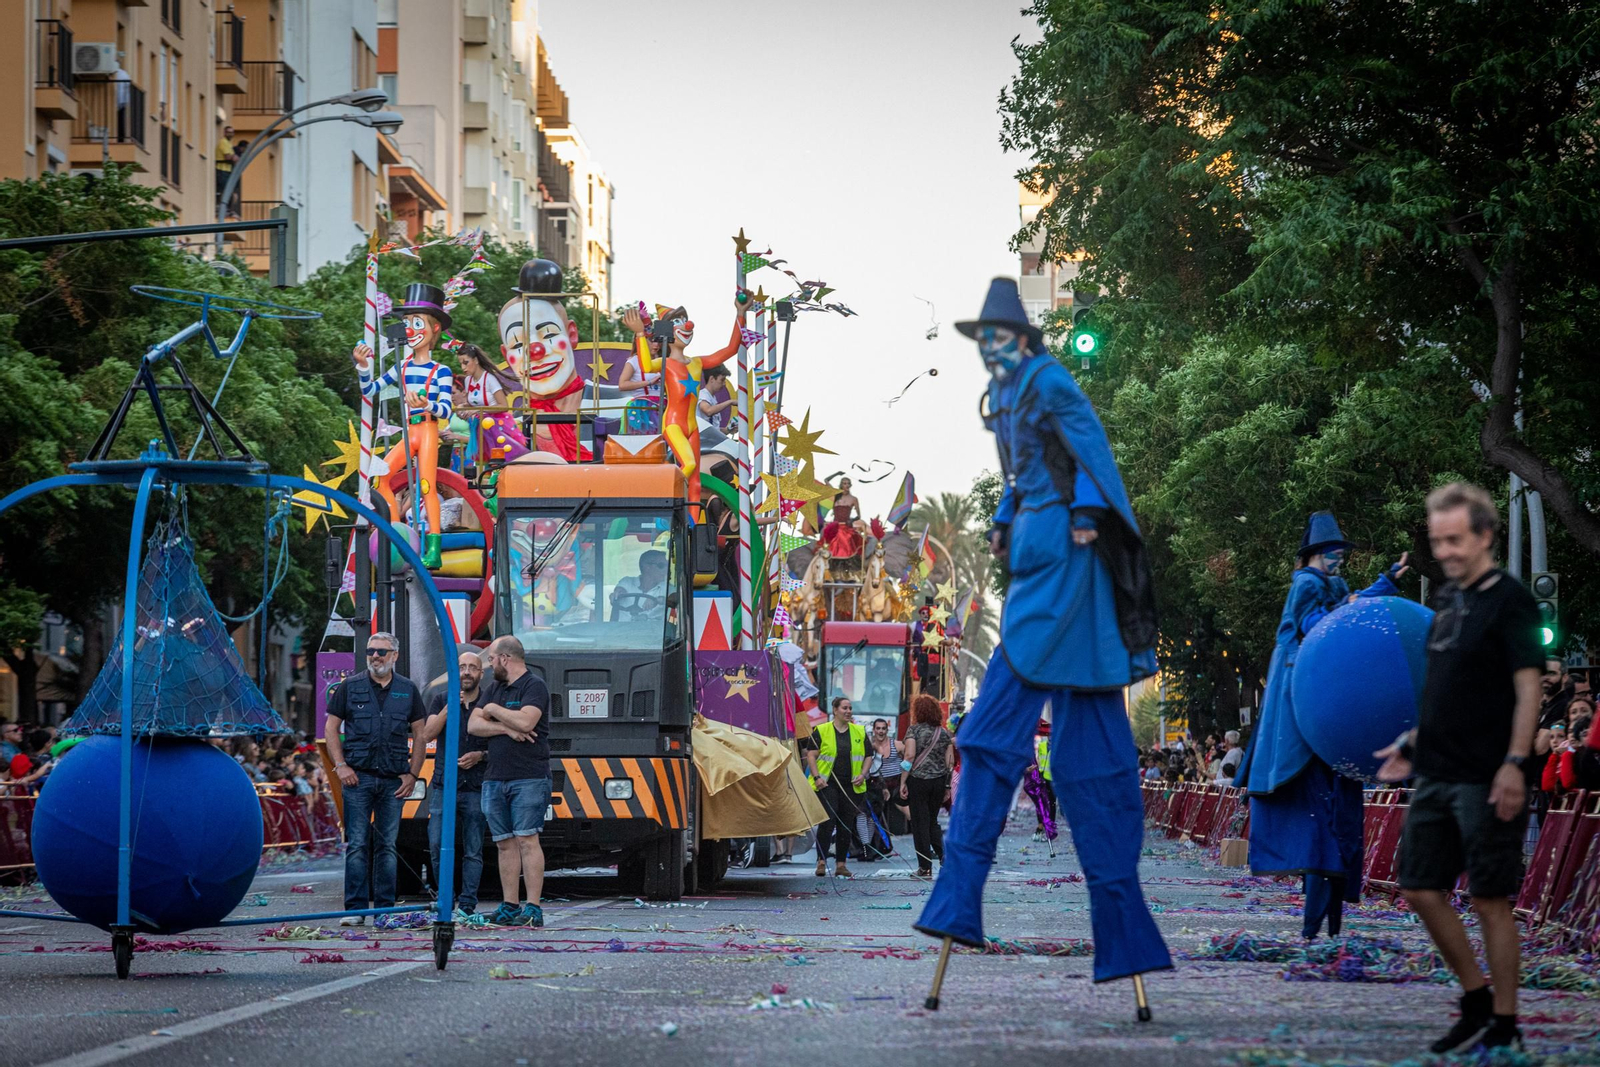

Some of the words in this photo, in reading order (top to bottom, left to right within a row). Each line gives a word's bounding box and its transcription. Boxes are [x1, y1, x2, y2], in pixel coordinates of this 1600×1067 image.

[575, 693, 581, 703] E
[584, 693, 606, 703] 2087
[580, 704, 596, 715] BFT
